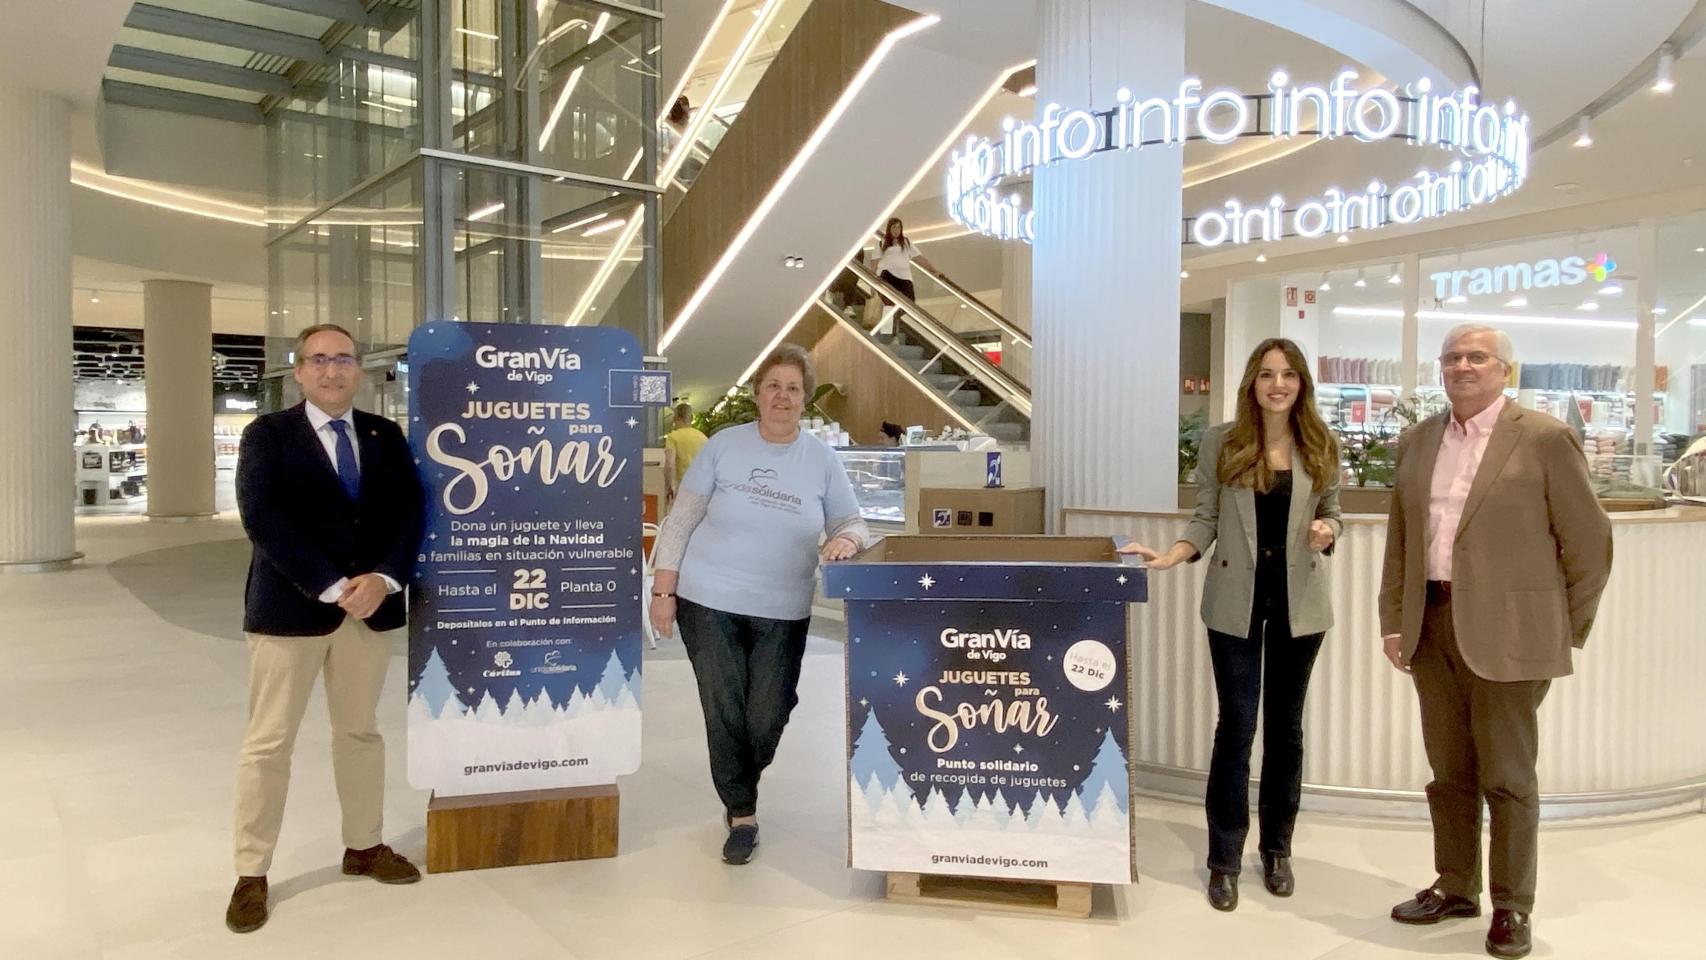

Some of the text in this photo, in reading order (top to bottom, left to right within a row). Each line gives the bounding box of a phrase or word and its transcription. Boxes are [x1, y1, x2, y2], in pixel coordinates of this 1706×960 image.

[1003, 103, 1097, 174] info
[1117, 79, 1247, 149] info
[1271, 71, 1399, 138] info
[1416, 77, 1500, 154] info
[475, 345, 582, 371] GranVía
[507, 371, 553, 385] de Vigo
[461, 401, 591, 420] JUGUETES
[569, 424, 603, 436] para
[426, 422, 627, 516] Soñar
[451, 519, 604, 532] Dona un juguete y lleva
[450, 533, 604, 547] la magia de la Navidad
[417, 547, 634, 562] a familias en situación vulnerable
[512, 568, 547, 589] 22
[560, 580, 603, 592] Planta
[438, 583, 497, 596] Hasta el
[509, 592, 550, 610] DIC
[520, 618, 547, 626] Punto
[549, 617, 560, 625] de
[563, 615, 617, 624] Información
[486, 640, 498, 648] En
[940, 628, 1031, 650] GranVía
[966, 650, 1007, 662] de Vigo
[939, 670, 1031, 686] JUGUETES
[1071, 664, 1105, 680] 22 Dic
[1015, 687, 1040, 697] para
[915, 686, 1059, 753] Soñar
[464, 757, 589, 776] granviadevigo.com
[937, 758, 1039, 772] Punto solidario
[910, 771, 1067, 788] de recogida de juguetes
[931, 853, 1049, 869] granviadevigo.com
